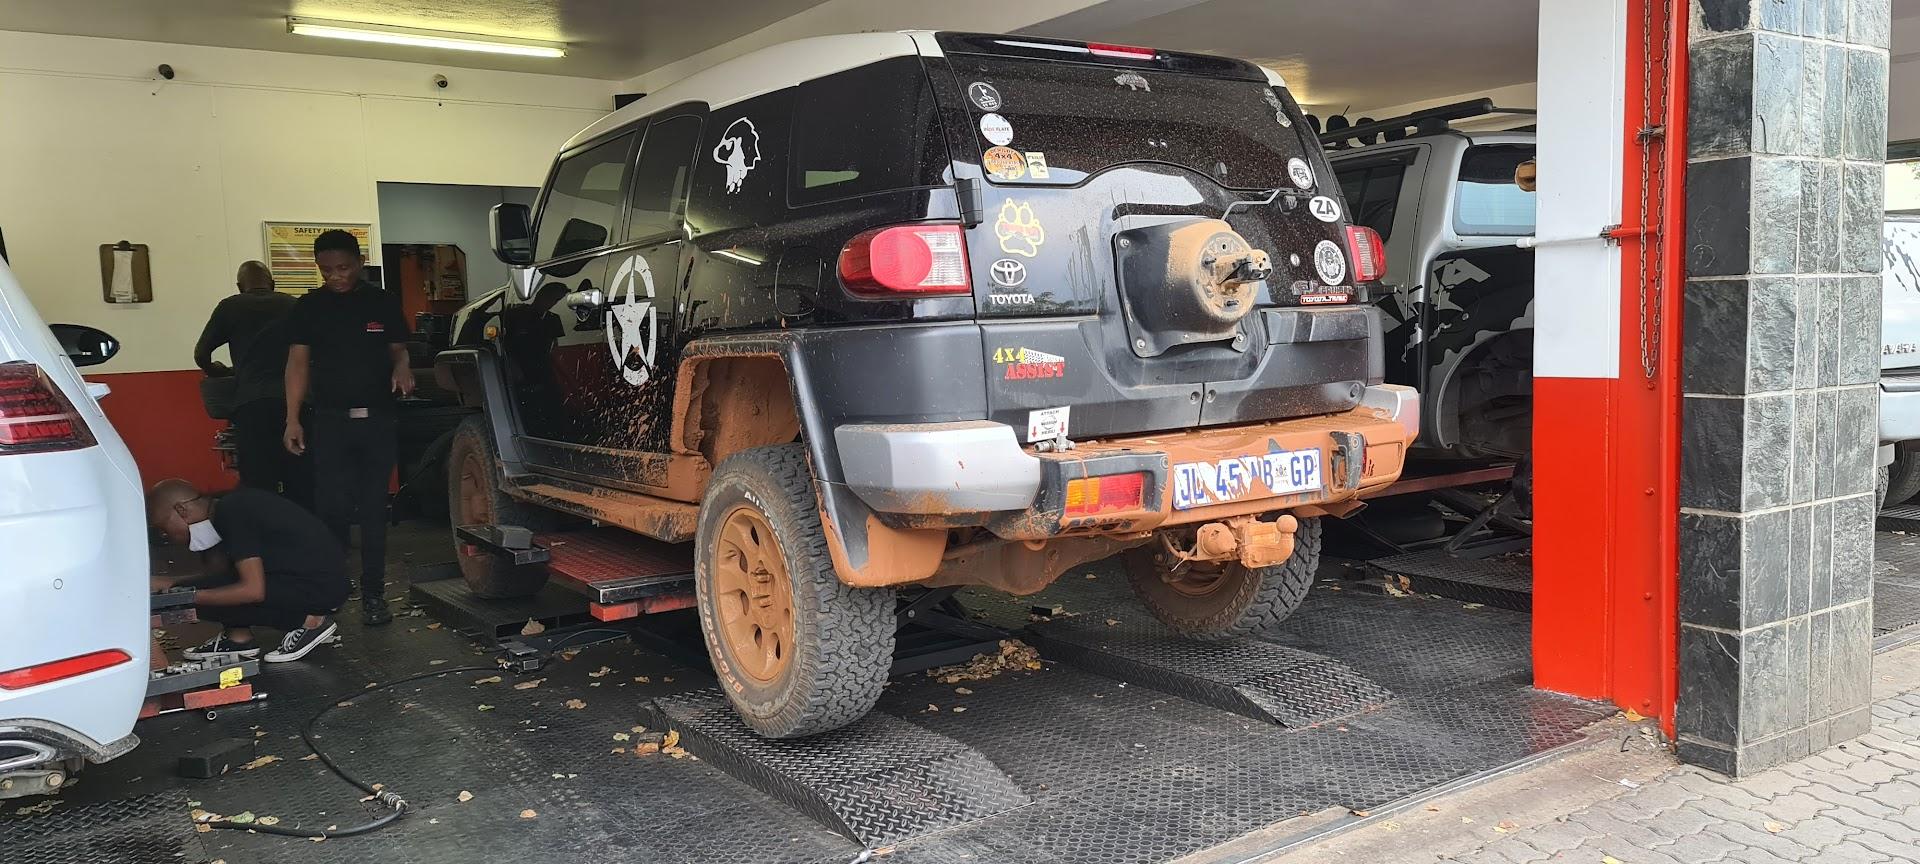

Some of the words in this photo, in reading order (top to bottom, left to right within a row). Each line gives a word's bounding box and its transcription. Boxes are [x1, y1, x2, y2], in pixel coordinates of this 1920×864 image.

[1314, 200, 1336, 216] ZA
[989, 294, 1035, 304] TOYOTA
[1004, 362, 1065, 380] ASSIST
[1181, 468, 1204, 501] JL
[1290, 454, 1315, 487] GP
